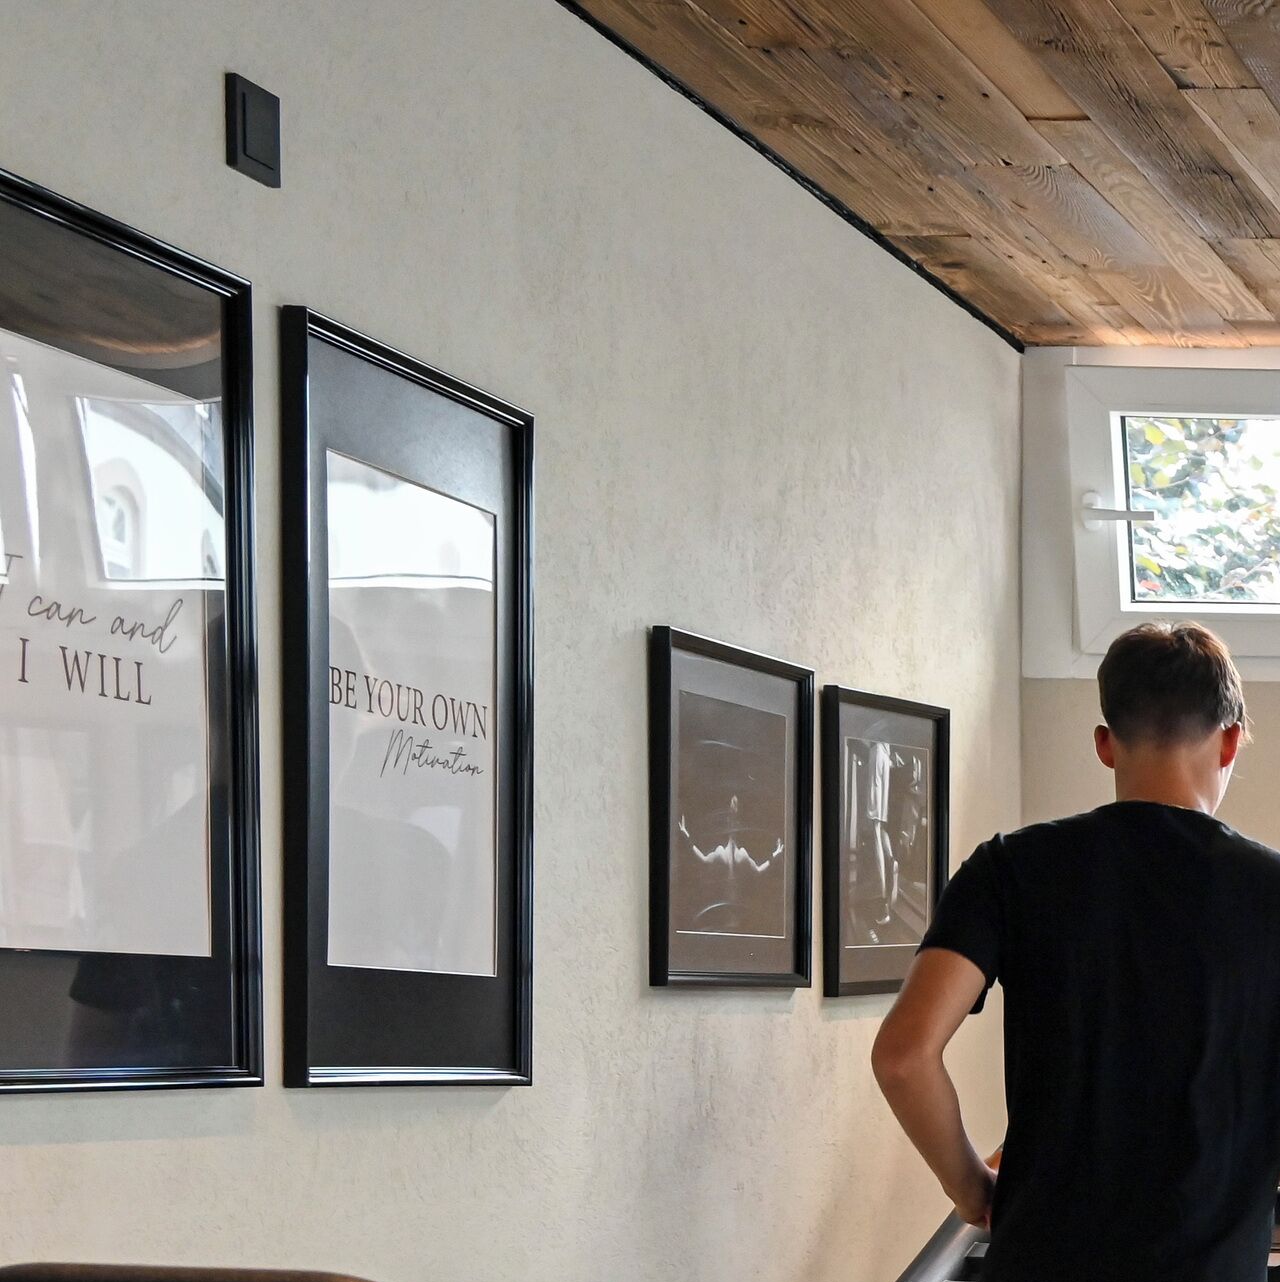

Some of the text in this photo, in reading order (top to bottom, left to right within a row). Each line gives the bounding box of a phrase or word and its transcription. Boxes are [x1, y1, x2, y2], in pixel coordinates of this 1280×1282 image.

[27, 595, 97, 628] can
[110, 598, 184, 654] and
[18, 637, 152, 705] I WILL
[329, 666, 488, 740] BE YOUR OWN
[380, 729, 484, 778] Motivation
